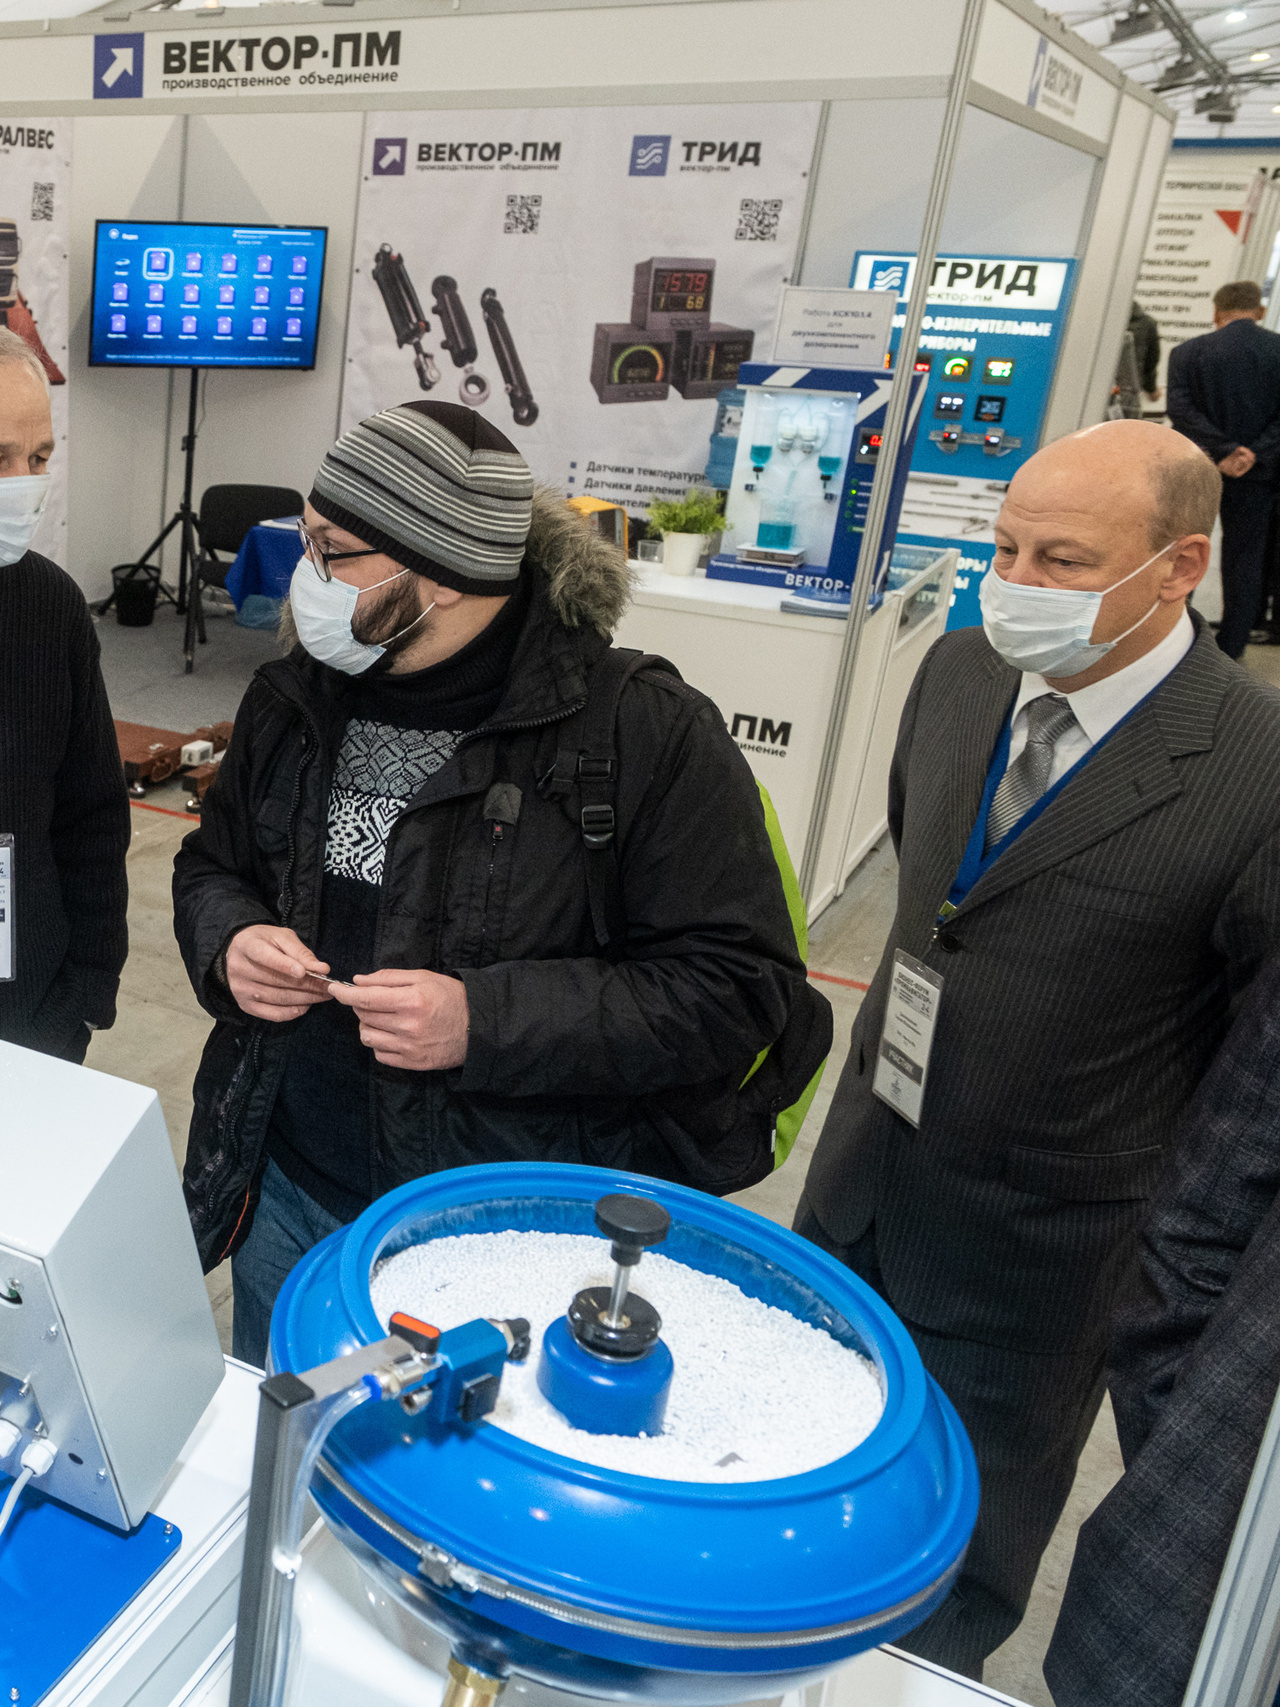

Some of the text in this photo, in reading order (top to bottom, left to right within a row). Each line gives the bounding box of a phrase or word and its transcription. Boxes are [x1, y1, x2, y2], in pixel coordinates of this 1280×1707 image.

[162, 71, 399, 91] производственное объединение
[682, 141, 761, 167] ТРИД
[919, 335, 977, 352] РИБОРЫ
[586, 461, 634, 474] Датчики
[584, 477, 632, 491] Датчики
[785, 573, 853, 591] ВЕКТОР-
[737, 741, 787, 758] инение
